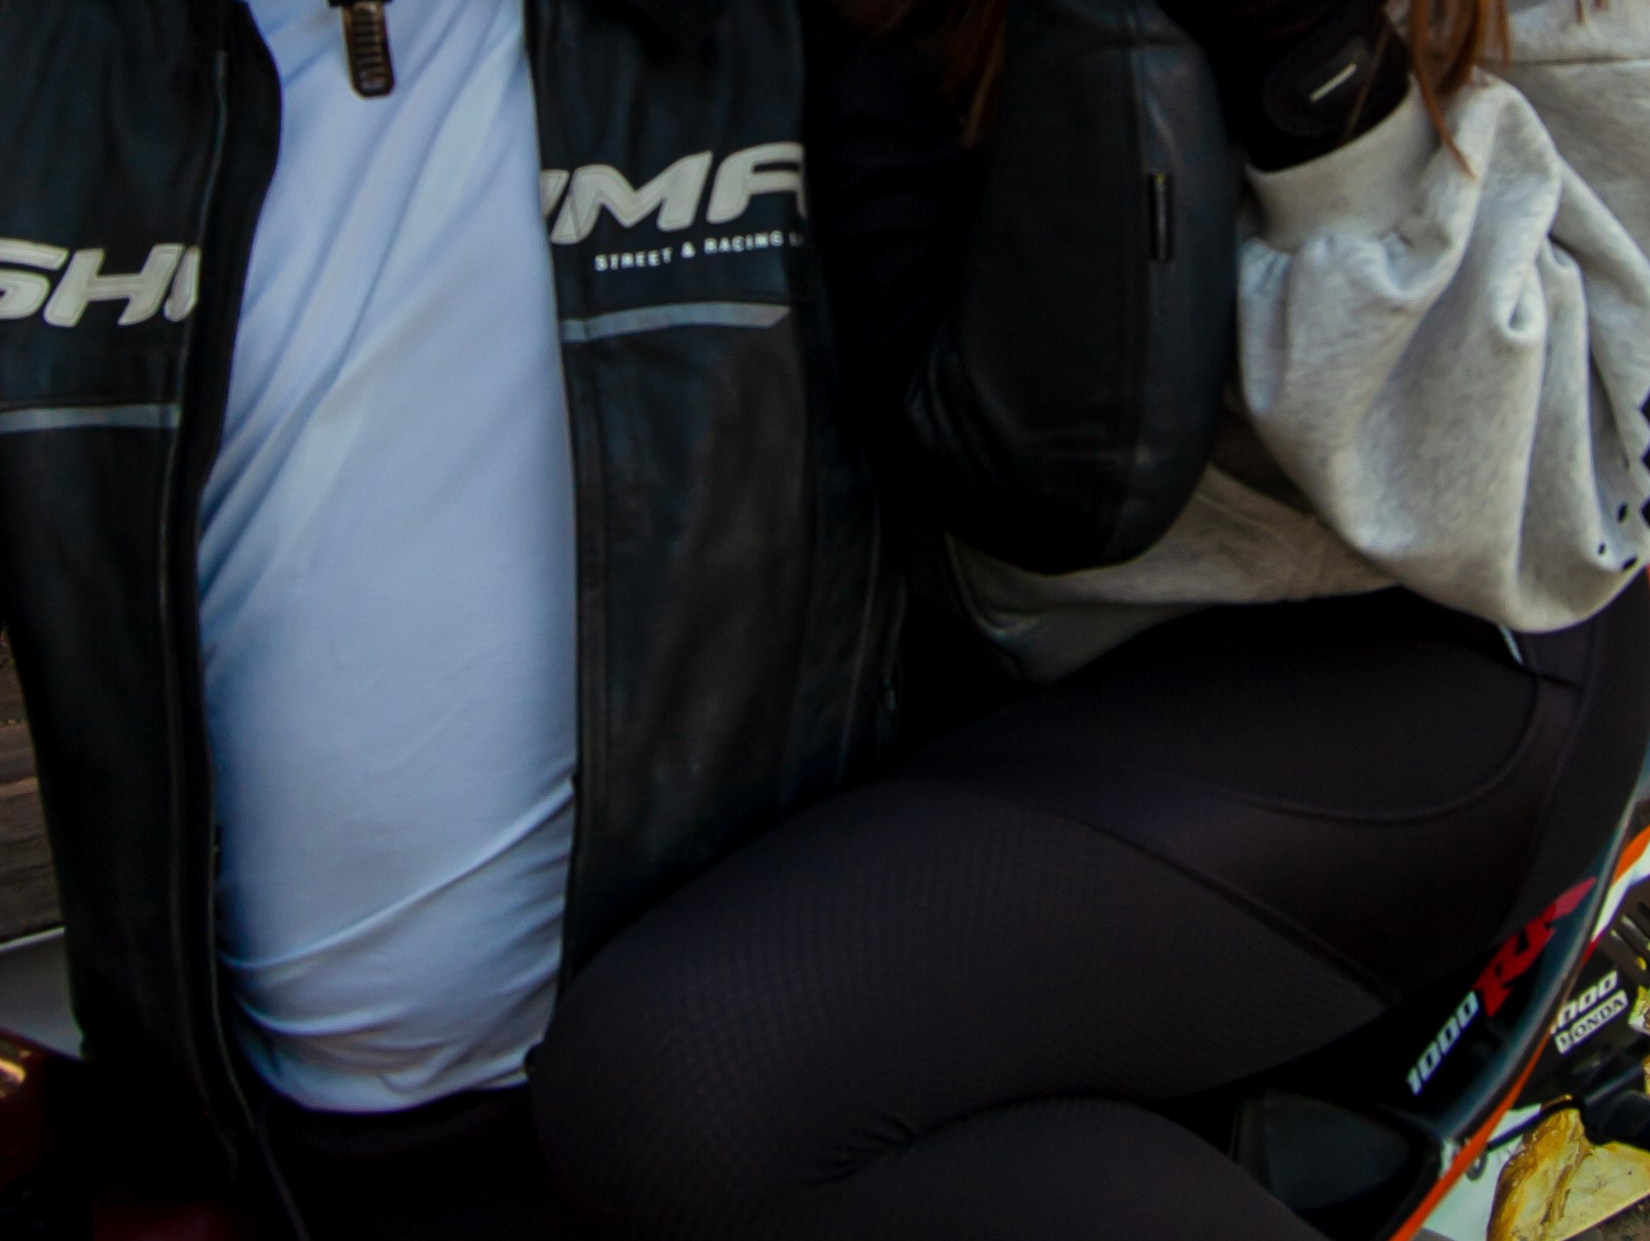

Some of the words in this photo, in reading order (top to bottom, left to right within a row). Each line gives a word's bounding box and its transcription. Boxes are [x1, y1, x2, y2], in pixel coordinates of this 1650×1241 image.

[594, 247, 672, 271] STREET
[681, 241, 696, 259] &
[703, 230, 785, 255] RACING
[1550, 969, 1618, 1034] 000
[1558, 995, 1626, 1048] HONDA
